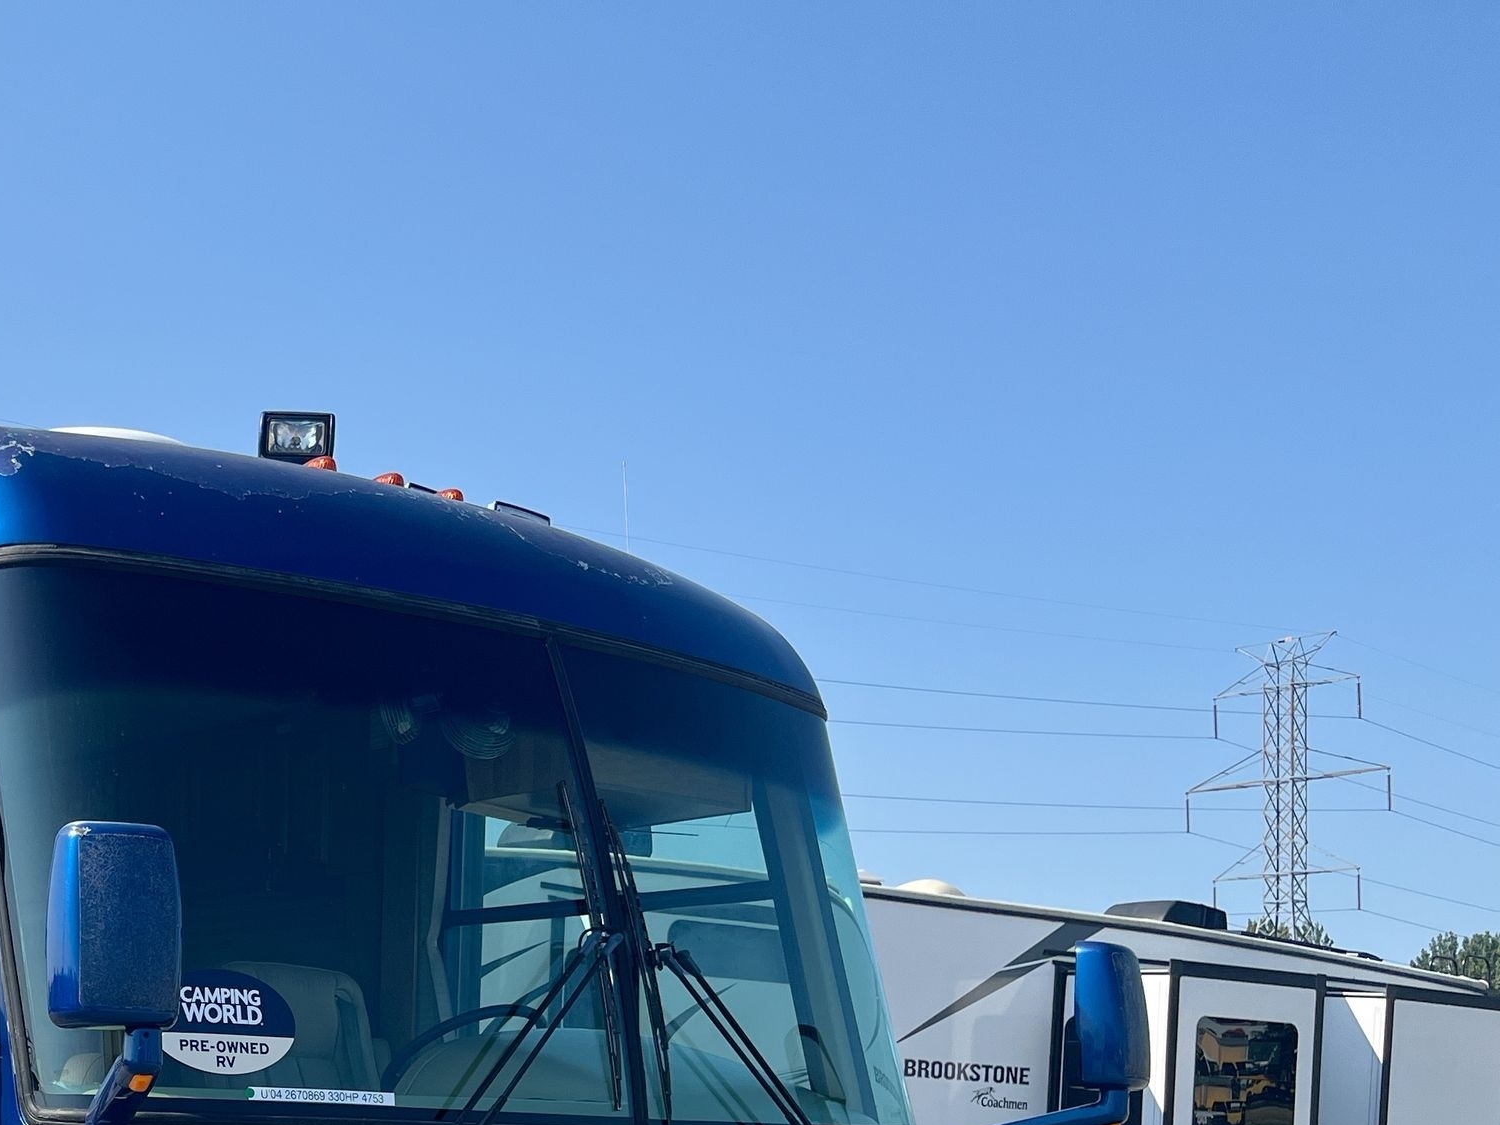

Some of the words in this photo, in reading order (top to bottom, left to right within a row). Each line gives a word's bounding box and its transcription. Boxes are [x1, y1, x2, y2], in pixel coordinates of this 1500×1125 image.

[180, 986, 261, 1006] CAMPING
[181, 1002, 263, 1025] WORLD
[180, 1039, 269, 1055] PRE-OWNED
[216, 1055, 236, 1068] RV
[903, 1058, 1030, 1086] BROOKSTONE
[284, 1089, 326, 1101] 2670869
[327, 1091, 359, 1103] 330HP
[361, 1093, 384, 1104] 4753
[980, 1096, 1028, 1111] Coachmen
